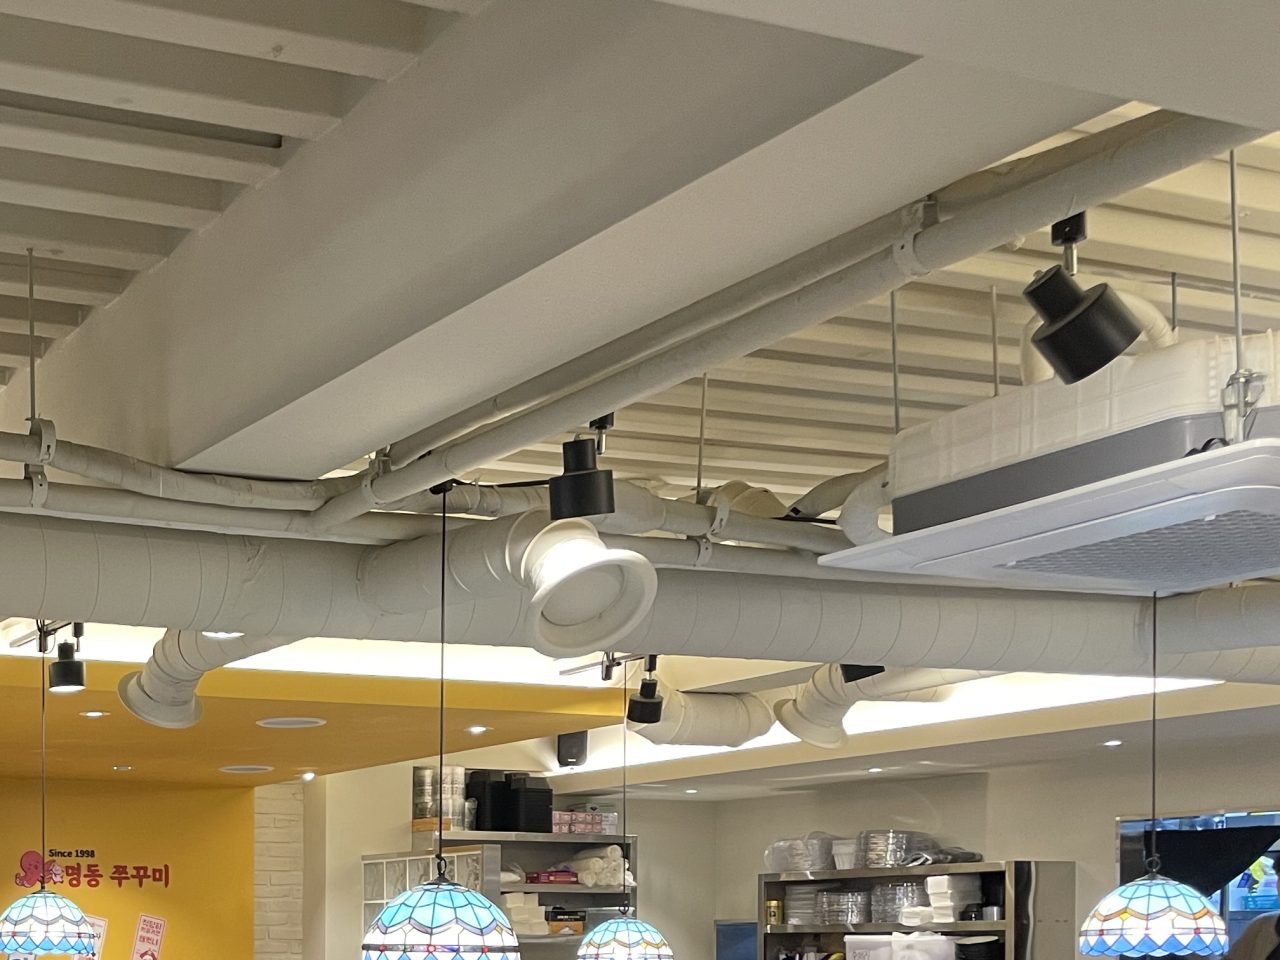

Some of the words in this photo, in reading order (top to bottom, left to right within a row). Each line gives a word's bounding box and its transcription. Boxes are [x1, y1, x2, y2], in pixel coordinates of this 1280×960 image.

[48, 849, 73, 858] Since
[74, 849, 95, 858] 1998
[64, 862, 104, 888] 명동
[109, 863, 170, 888] 쭈꾸미
